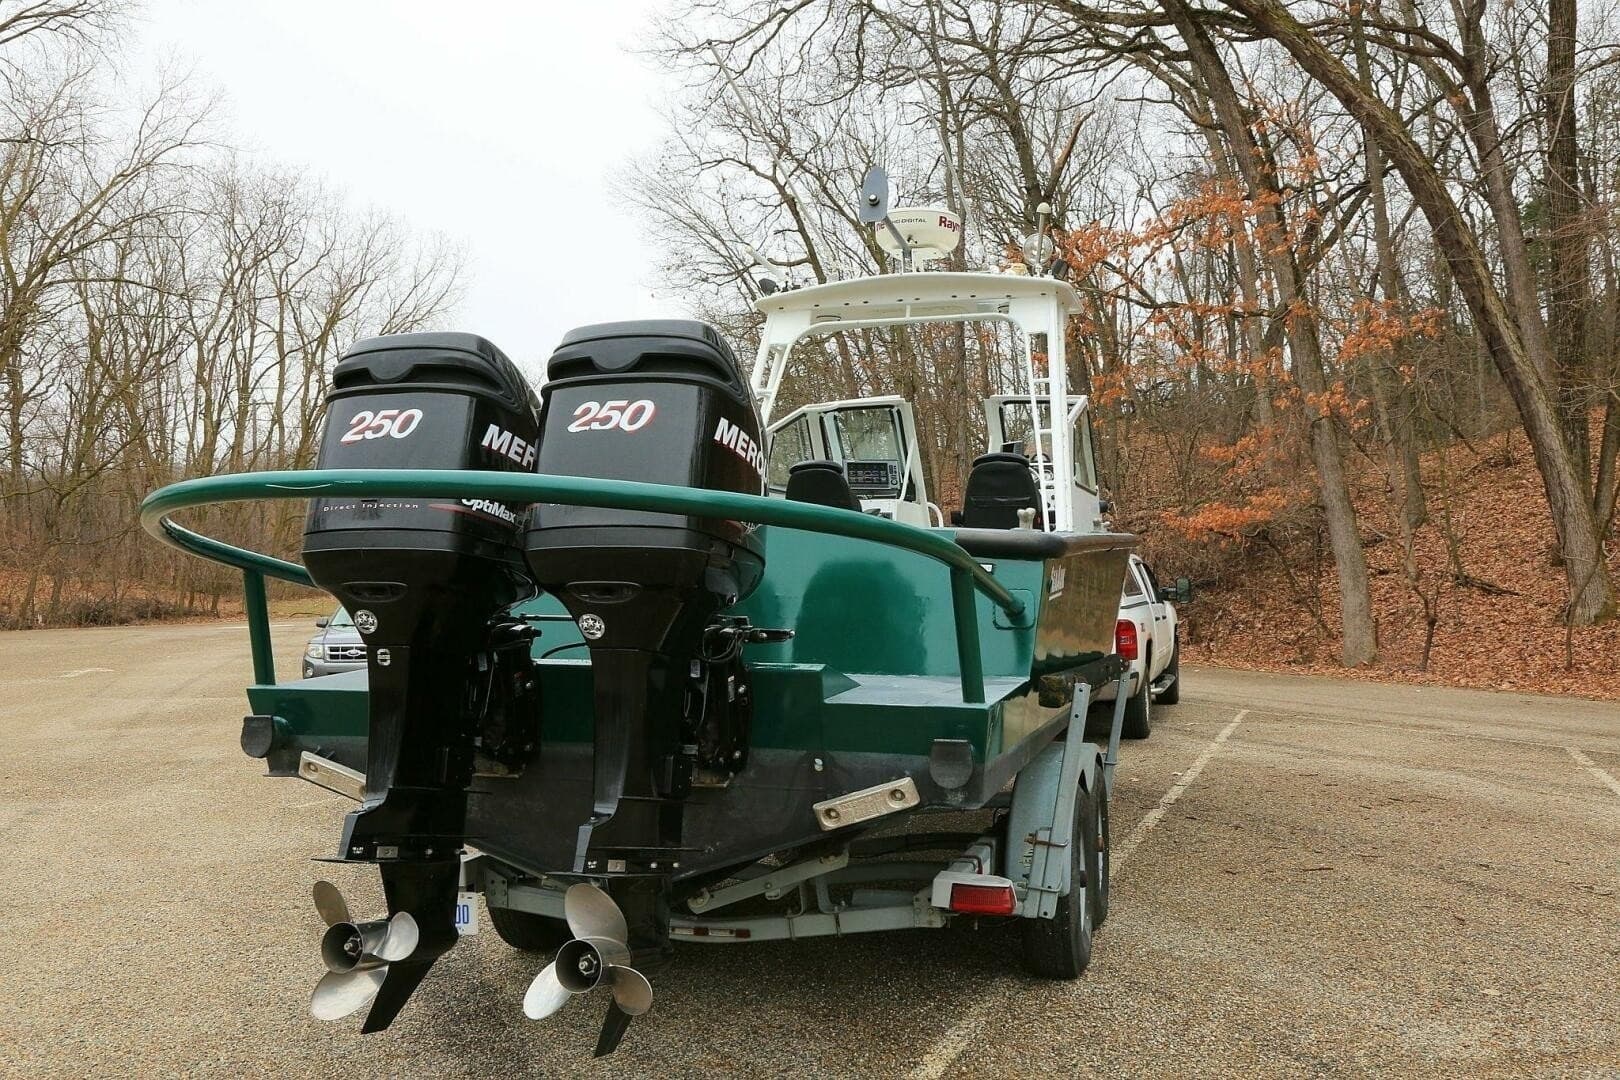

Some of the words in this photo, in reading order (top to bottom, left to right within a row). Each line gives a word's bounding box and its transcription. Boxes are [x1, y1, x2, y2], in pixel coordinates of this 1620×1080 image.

[341, 408, 423, 445] 250
[567, 400, 655, 433] 250
[323, 503, 356, 512] Direct
